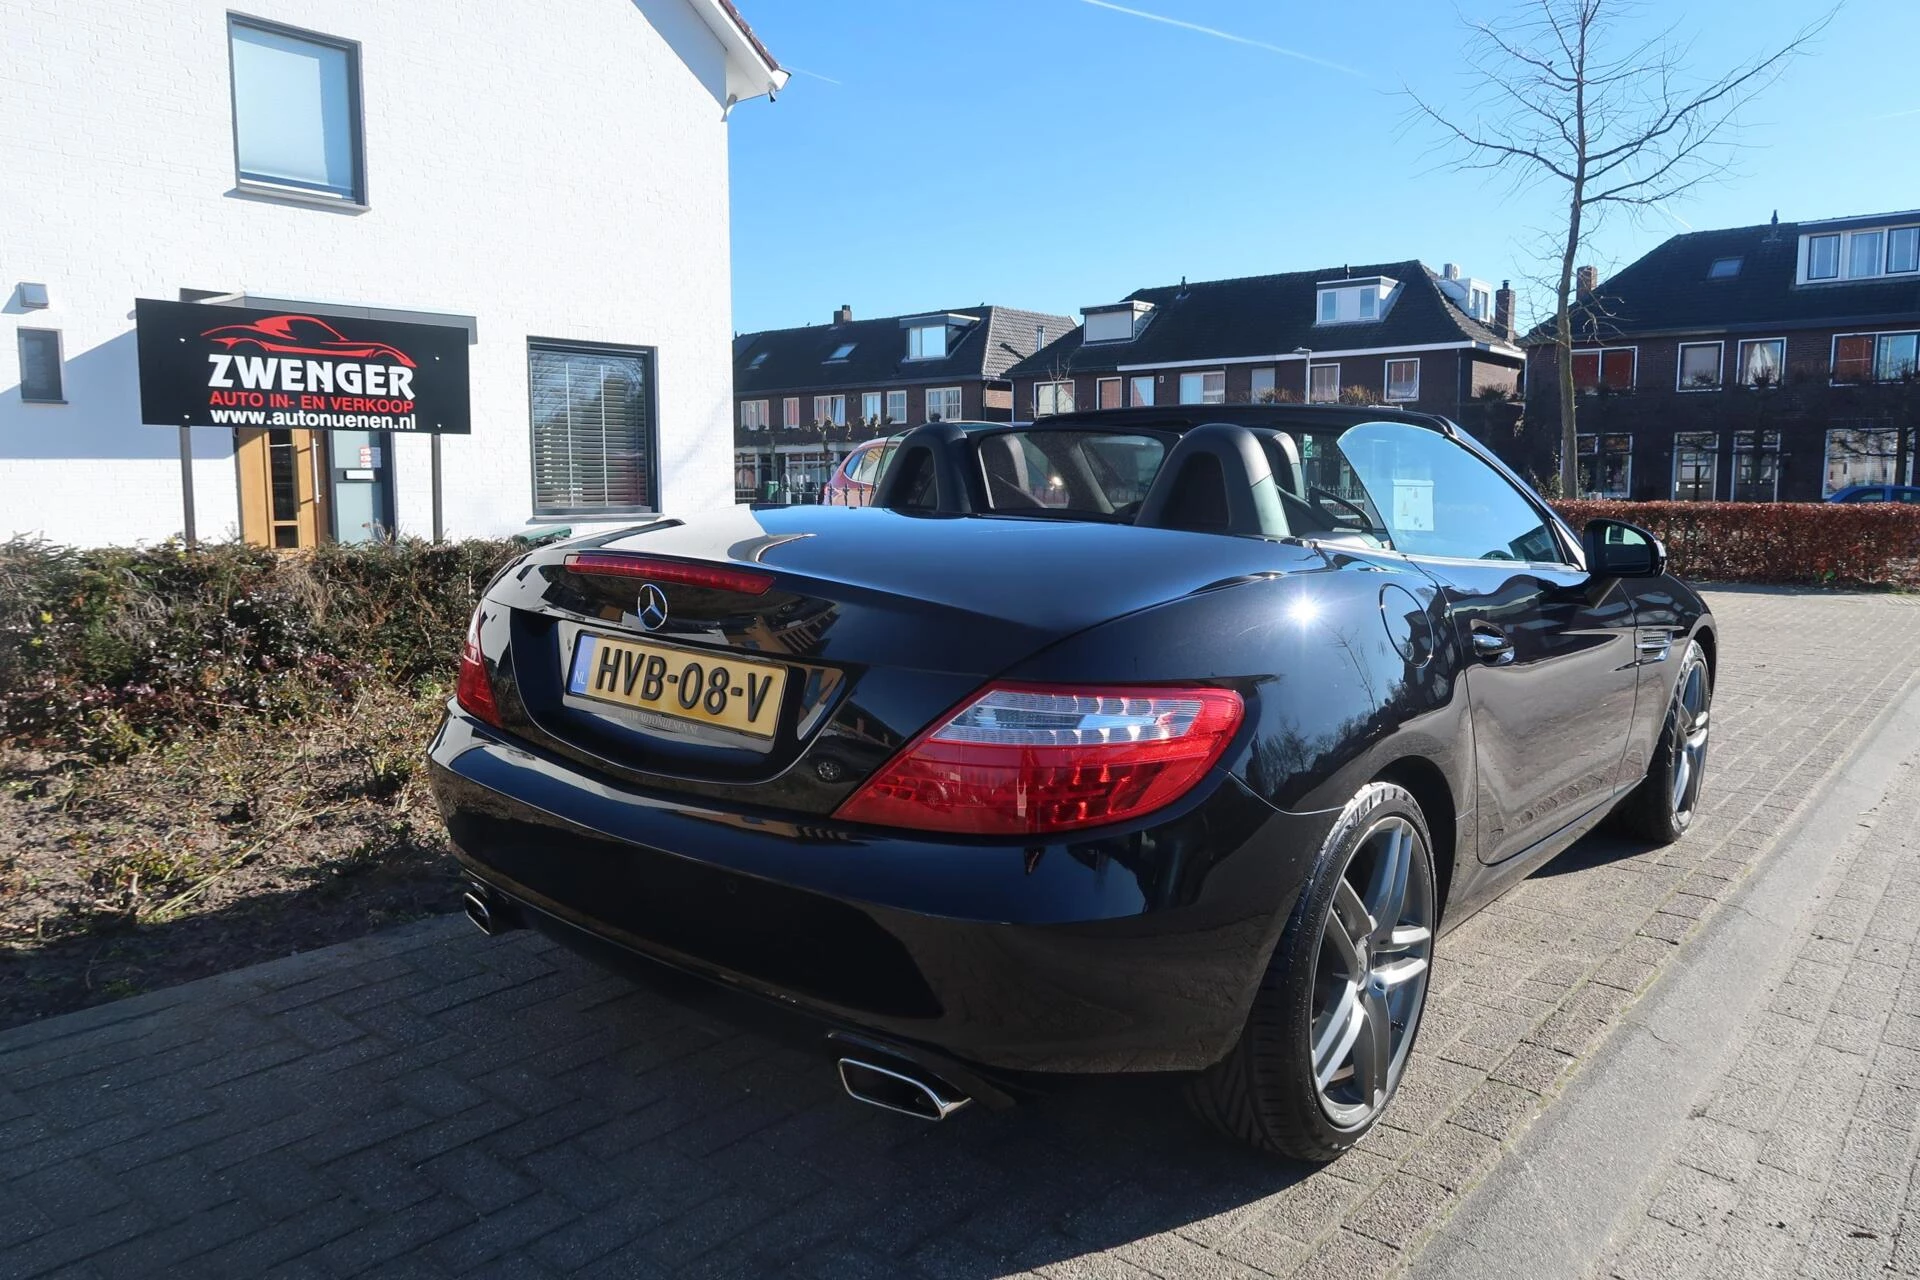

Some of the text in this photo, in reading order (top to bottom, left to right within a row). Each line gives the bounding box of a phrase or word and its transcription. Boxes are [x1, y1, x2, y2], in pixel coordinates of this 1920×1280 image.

[207, 354, 416, 401] ZWENGER
[210, 390, 414, 414] AUTO IN- EN VERKOOP
[210, 409, 416, 430] www.autonuenen.nl
[574, 671, 586, 685] NL
[595, 646, 772, 723] HVB-08-V
